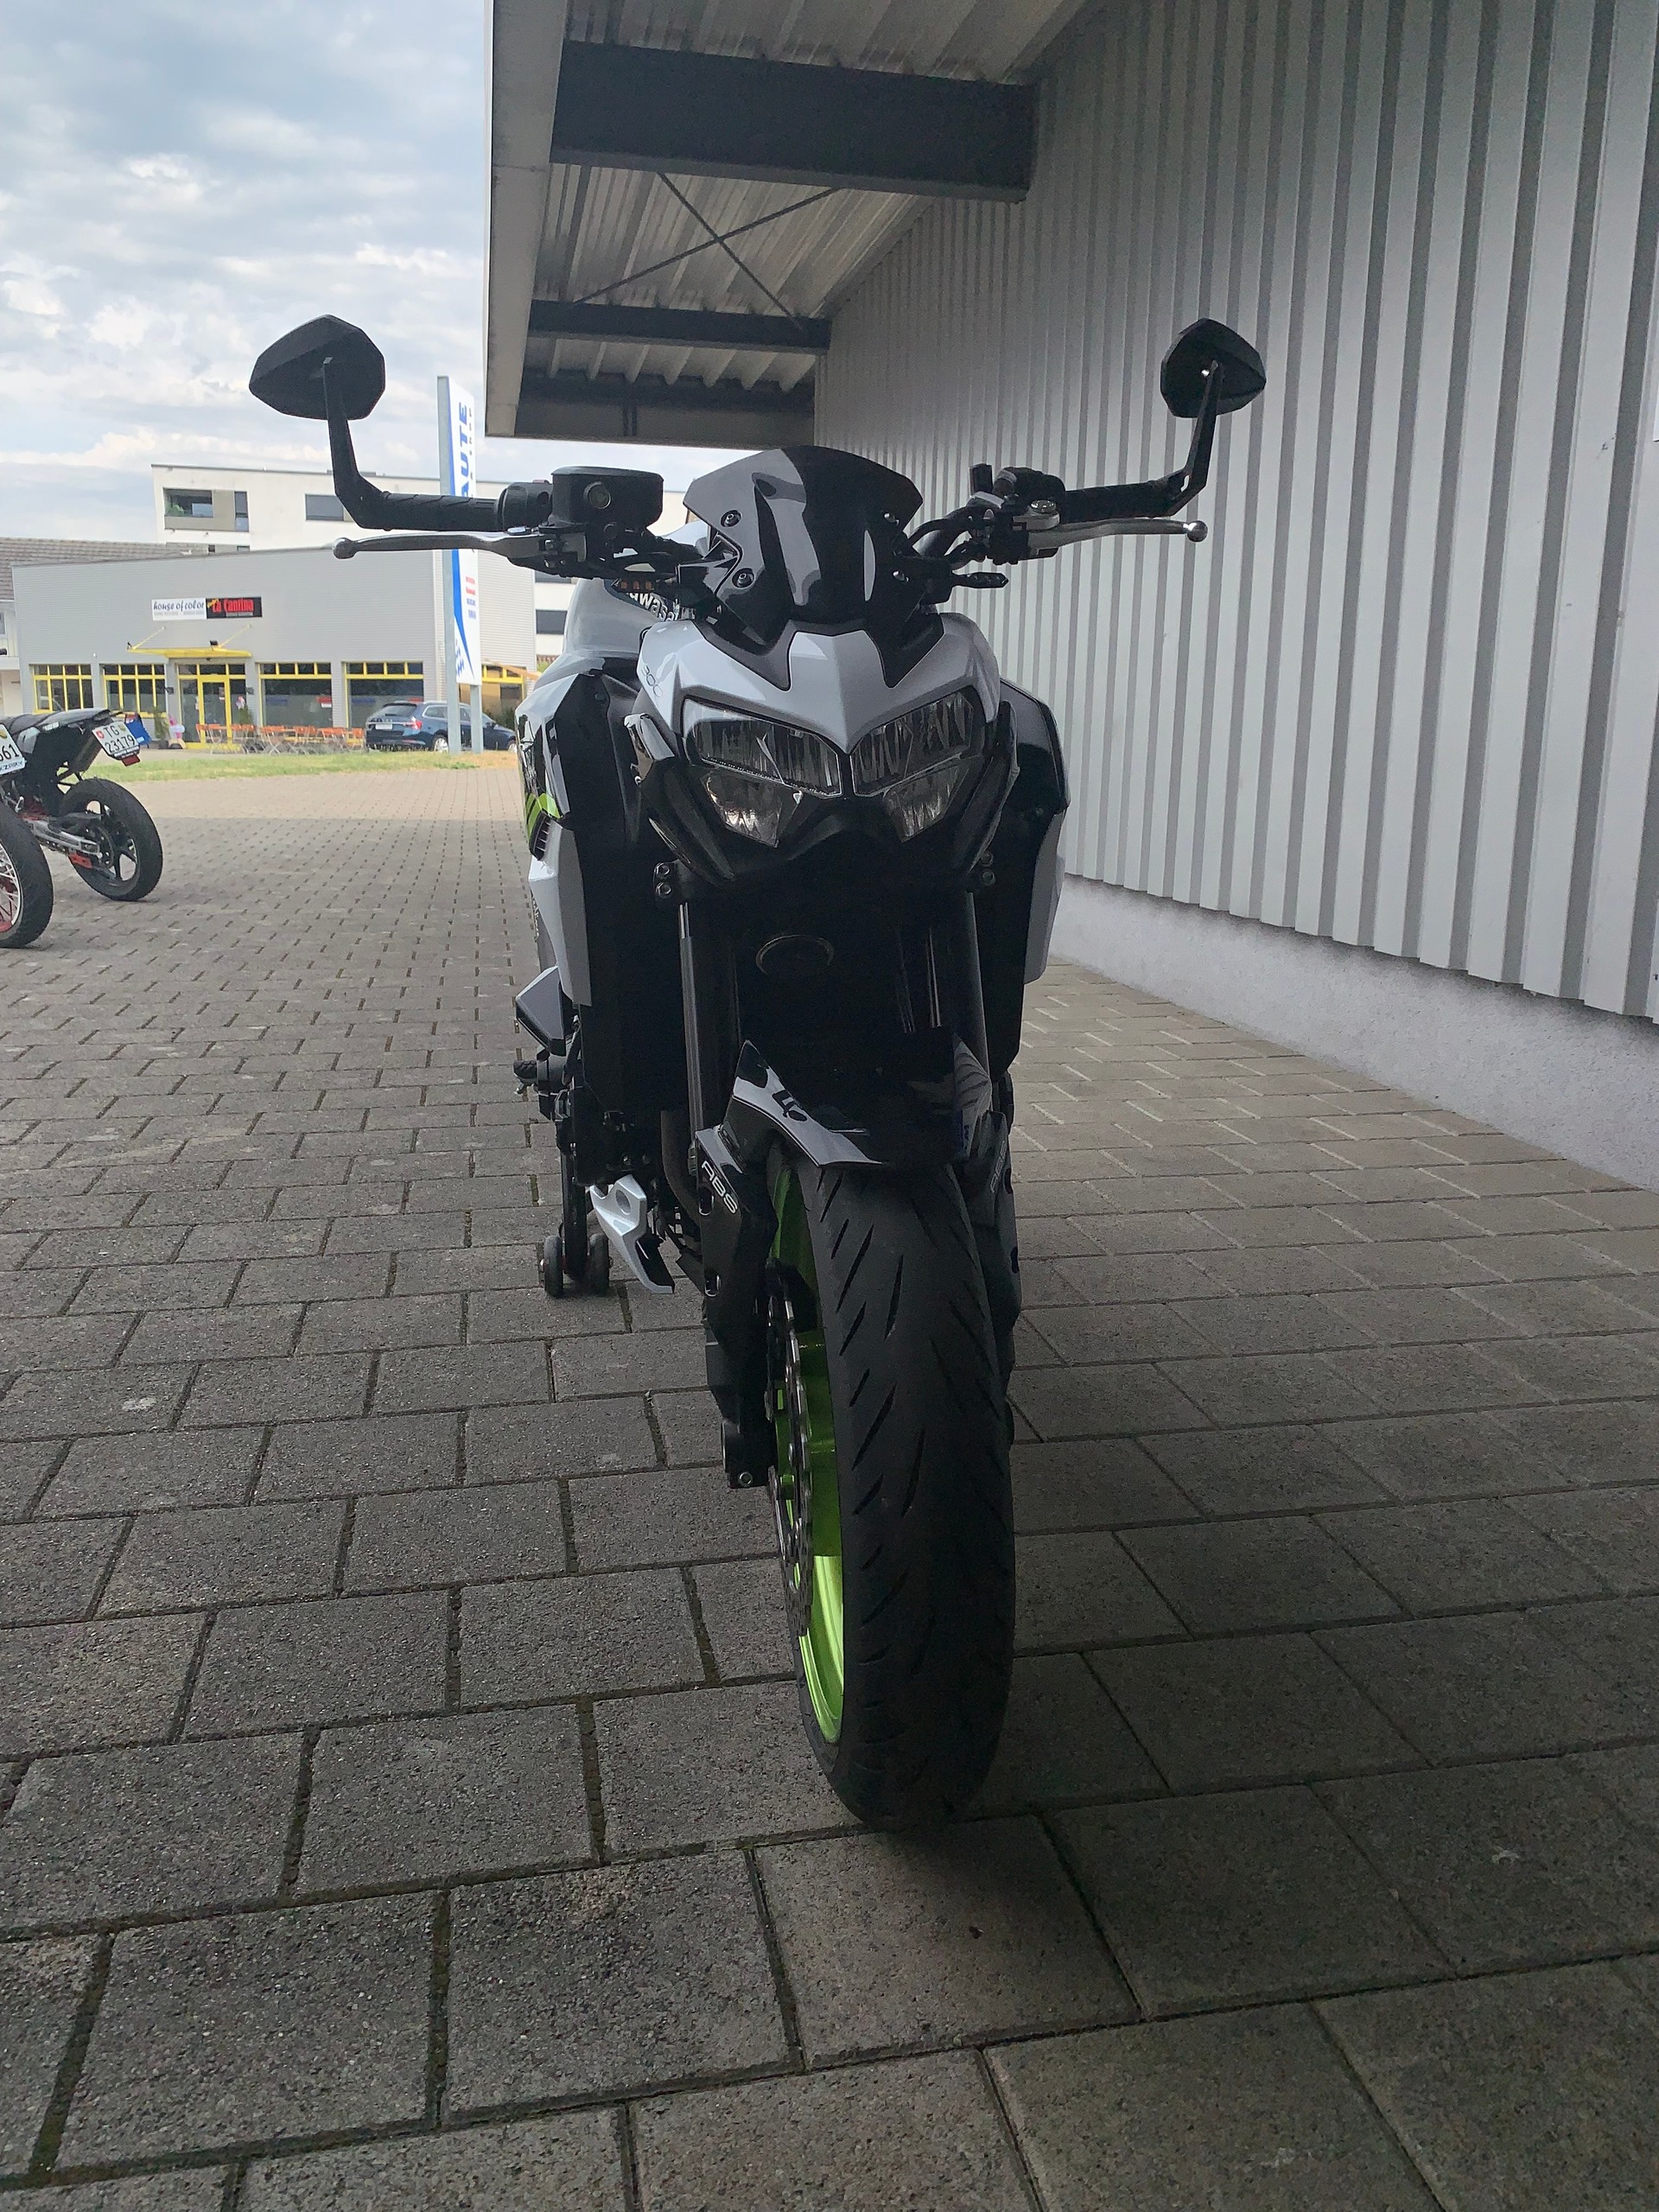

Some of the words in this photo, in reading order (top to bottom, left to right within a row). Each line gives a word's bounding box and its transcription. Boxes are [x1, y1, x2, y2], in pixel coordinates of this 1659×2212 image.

[153, 601, 175, 611] house
[175, 601, 184, 613] of
[184, 600, 204, 610] color
[103, 725, 120, 738] TG
[105, 734, 135, 753] 23179
[701, 1160, 738, 1214] ABS
